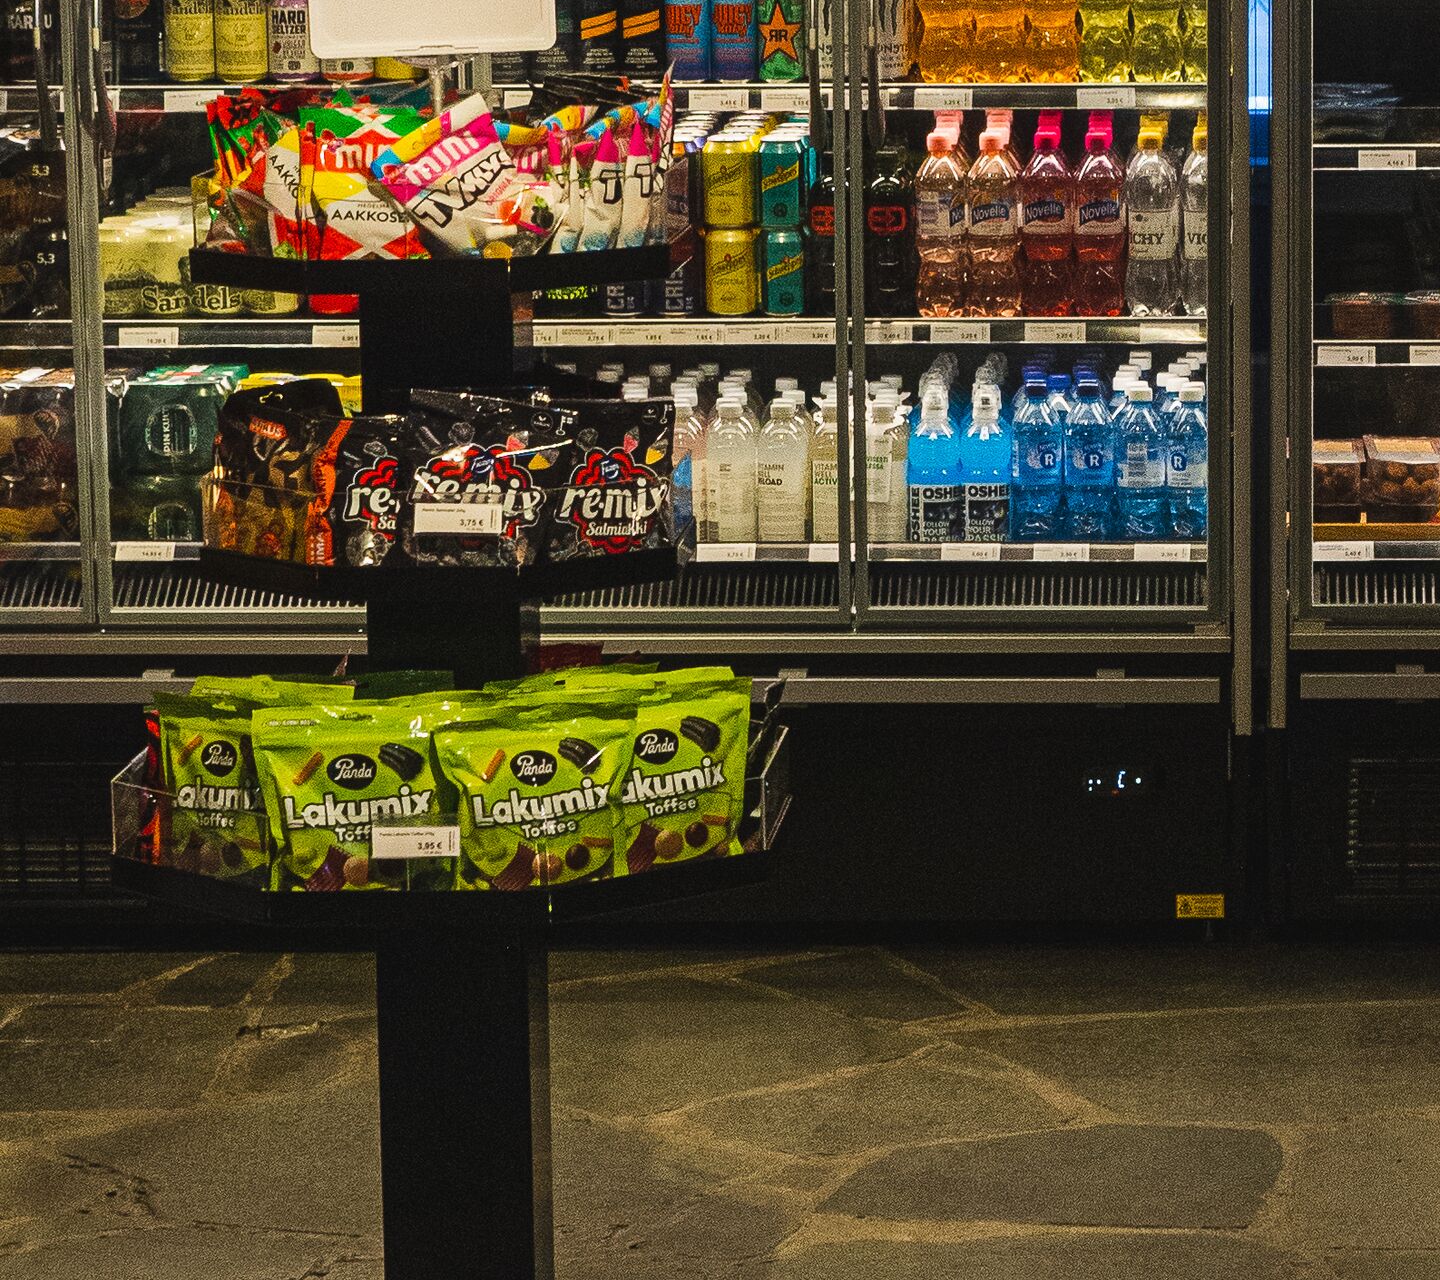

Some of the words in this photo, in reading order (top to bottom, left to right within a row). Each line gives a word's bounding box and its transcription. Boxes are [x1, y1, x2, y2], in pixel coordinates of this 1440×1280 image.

[7, 14, 52, 30] KARU
[971, 204, 1006, 221] Novelle
[1026, 203, 1061, 220] Novelle
[1081, 203, 1118, 221] Novelle
[141, 284, 242, 313] Sandels
[460, 519, 477, 527] 3,75
[586, 521, 647, 537] Salmiakki
[207, 744, 234, 767] Panda
[640, 735, 675, 756] Panda
[334, 758, 373, 781] Panda
[517, 755, 554, 777] Panda
[283, 784, 432, 829] Lakumix
[472, 779, 611, 828] Lakumix
[646, 797, 698, 817] Toffee
[523, 819, 577, 839] Toffee
[417, 841, 435, 851] 3,95
